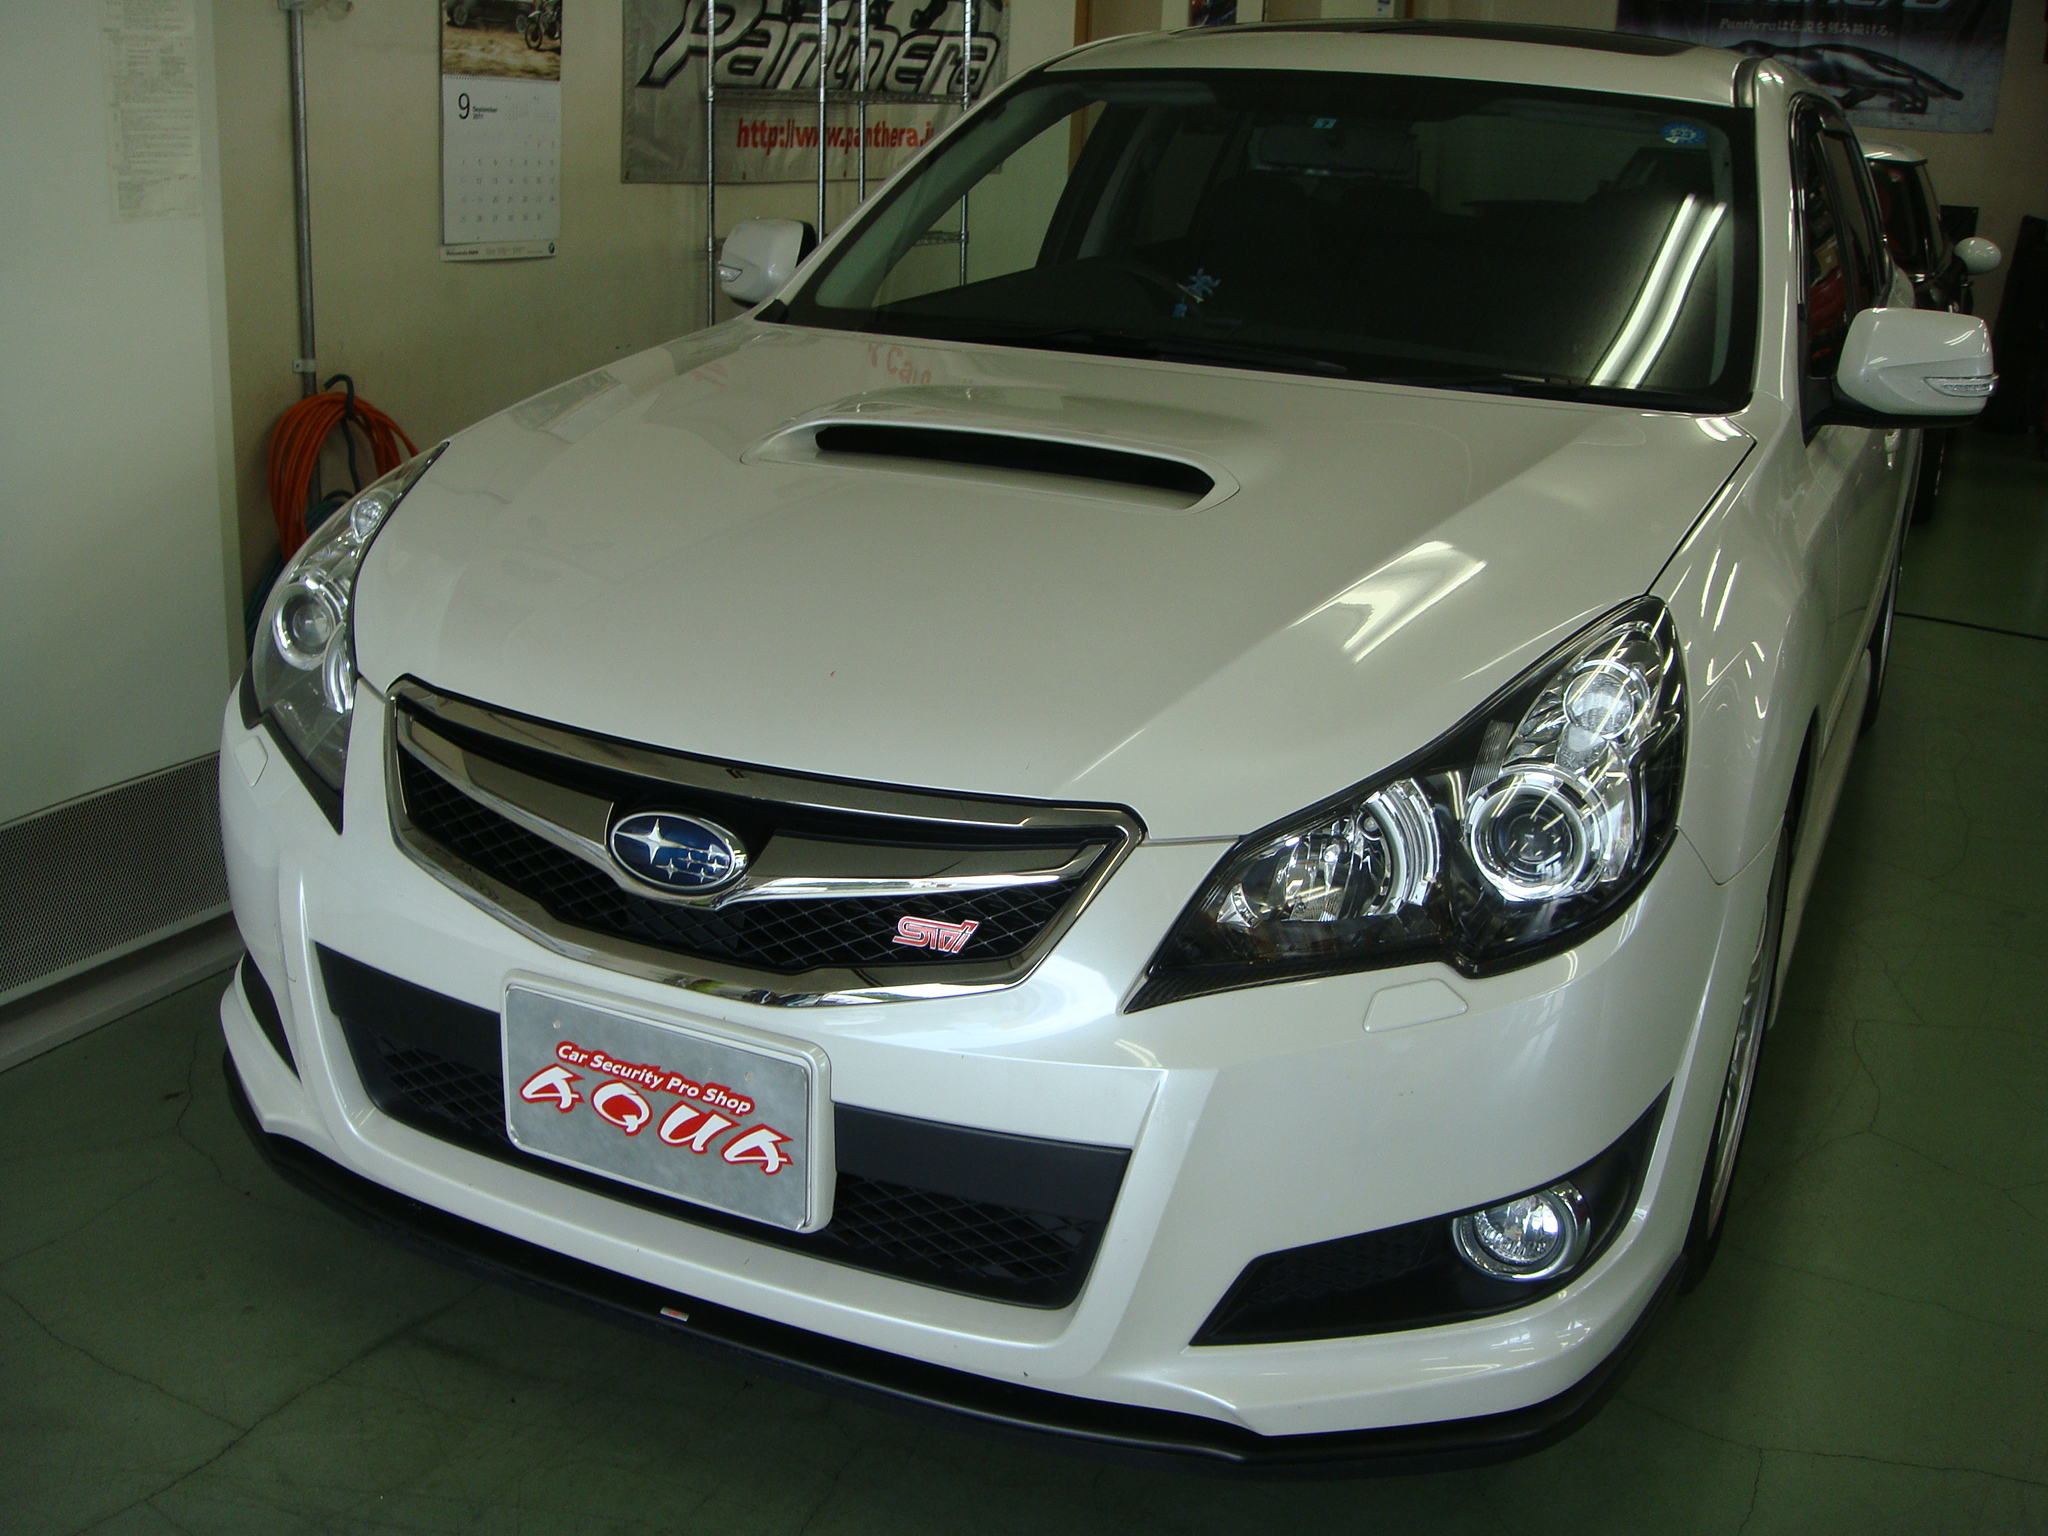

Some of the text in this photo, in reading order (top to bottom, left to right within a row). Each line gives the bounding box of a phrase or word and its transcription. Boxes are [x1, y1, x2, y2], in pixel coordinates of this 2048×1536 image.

[458, 92, 470, 120] 9
[736, 118, 935, 155] http://www.panthera.j
[557, 1045, 751, 1114] Car Security Pro Shop
[522, 1066, 788, 1173] AQUA
